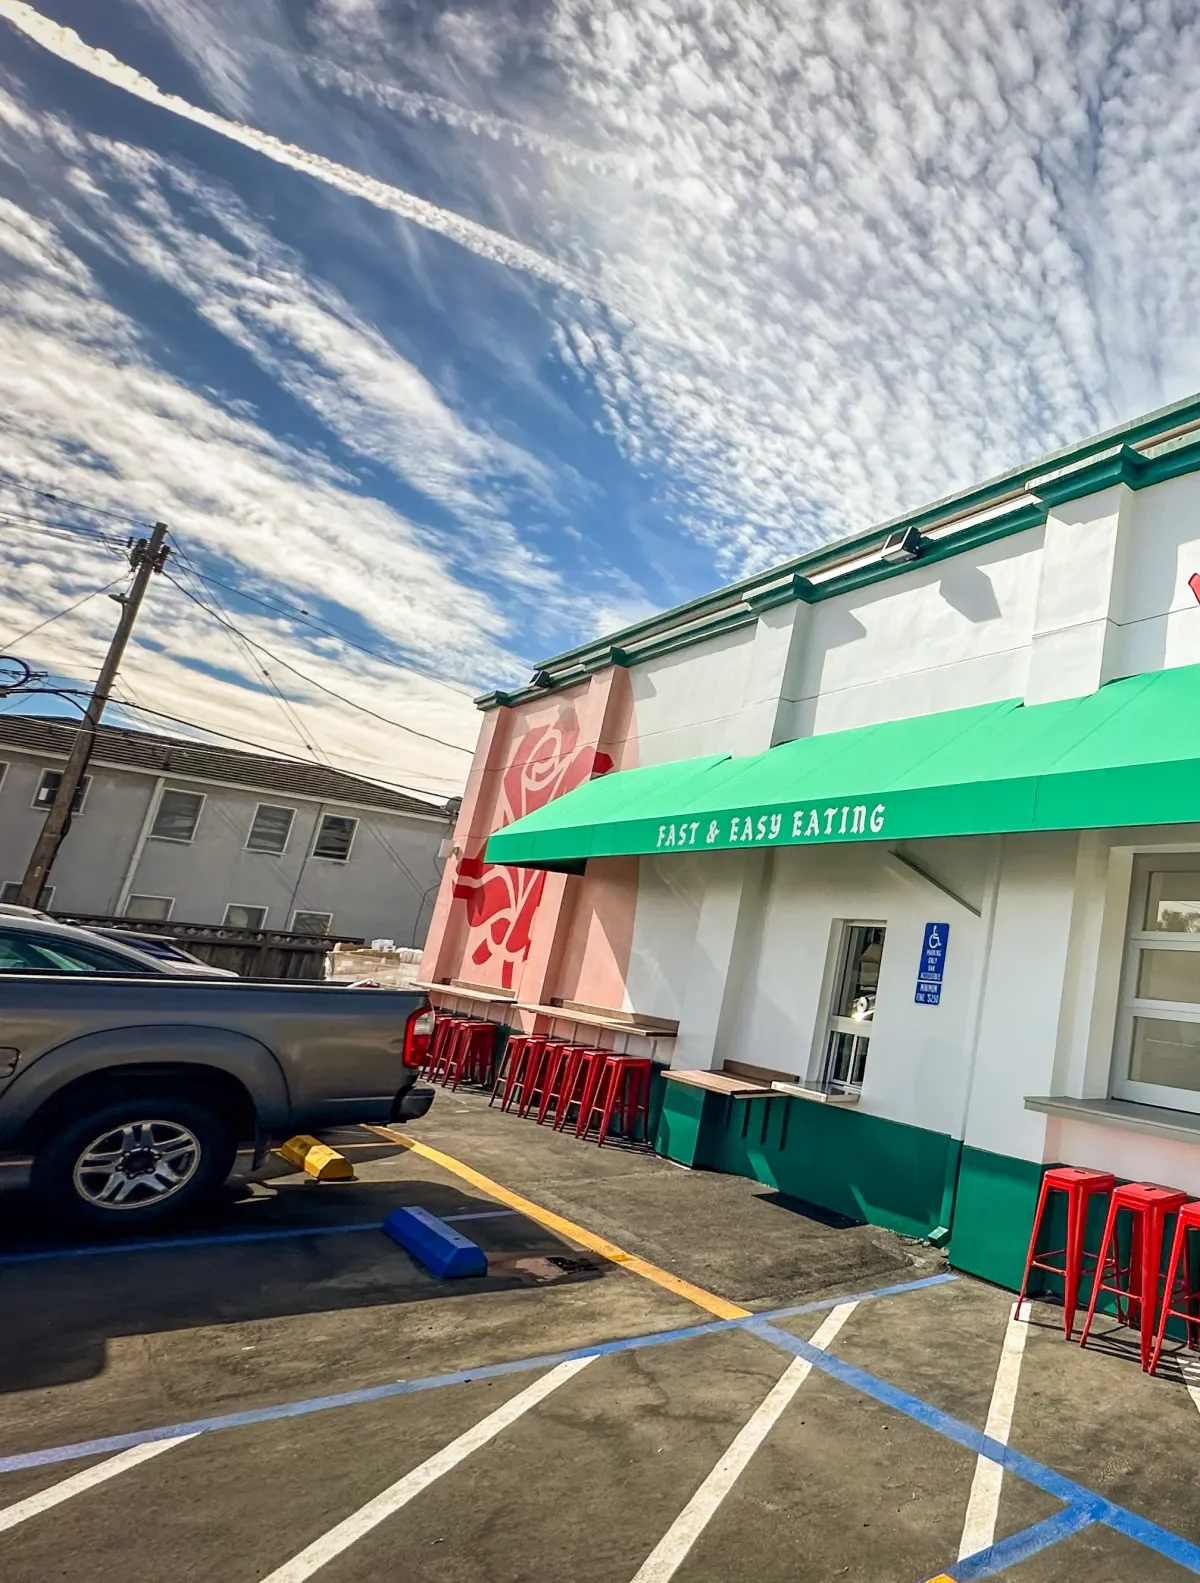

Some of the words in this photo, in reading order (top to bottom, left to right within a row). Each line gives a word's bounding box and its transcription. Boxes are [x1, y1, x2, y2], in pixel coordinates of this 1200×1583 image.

[656, 821, 700, 848] FAST
[706, 820, 720, 844] &
[729, 813, 782, 842] EASY
[792, 803, 886, 838] EATING
